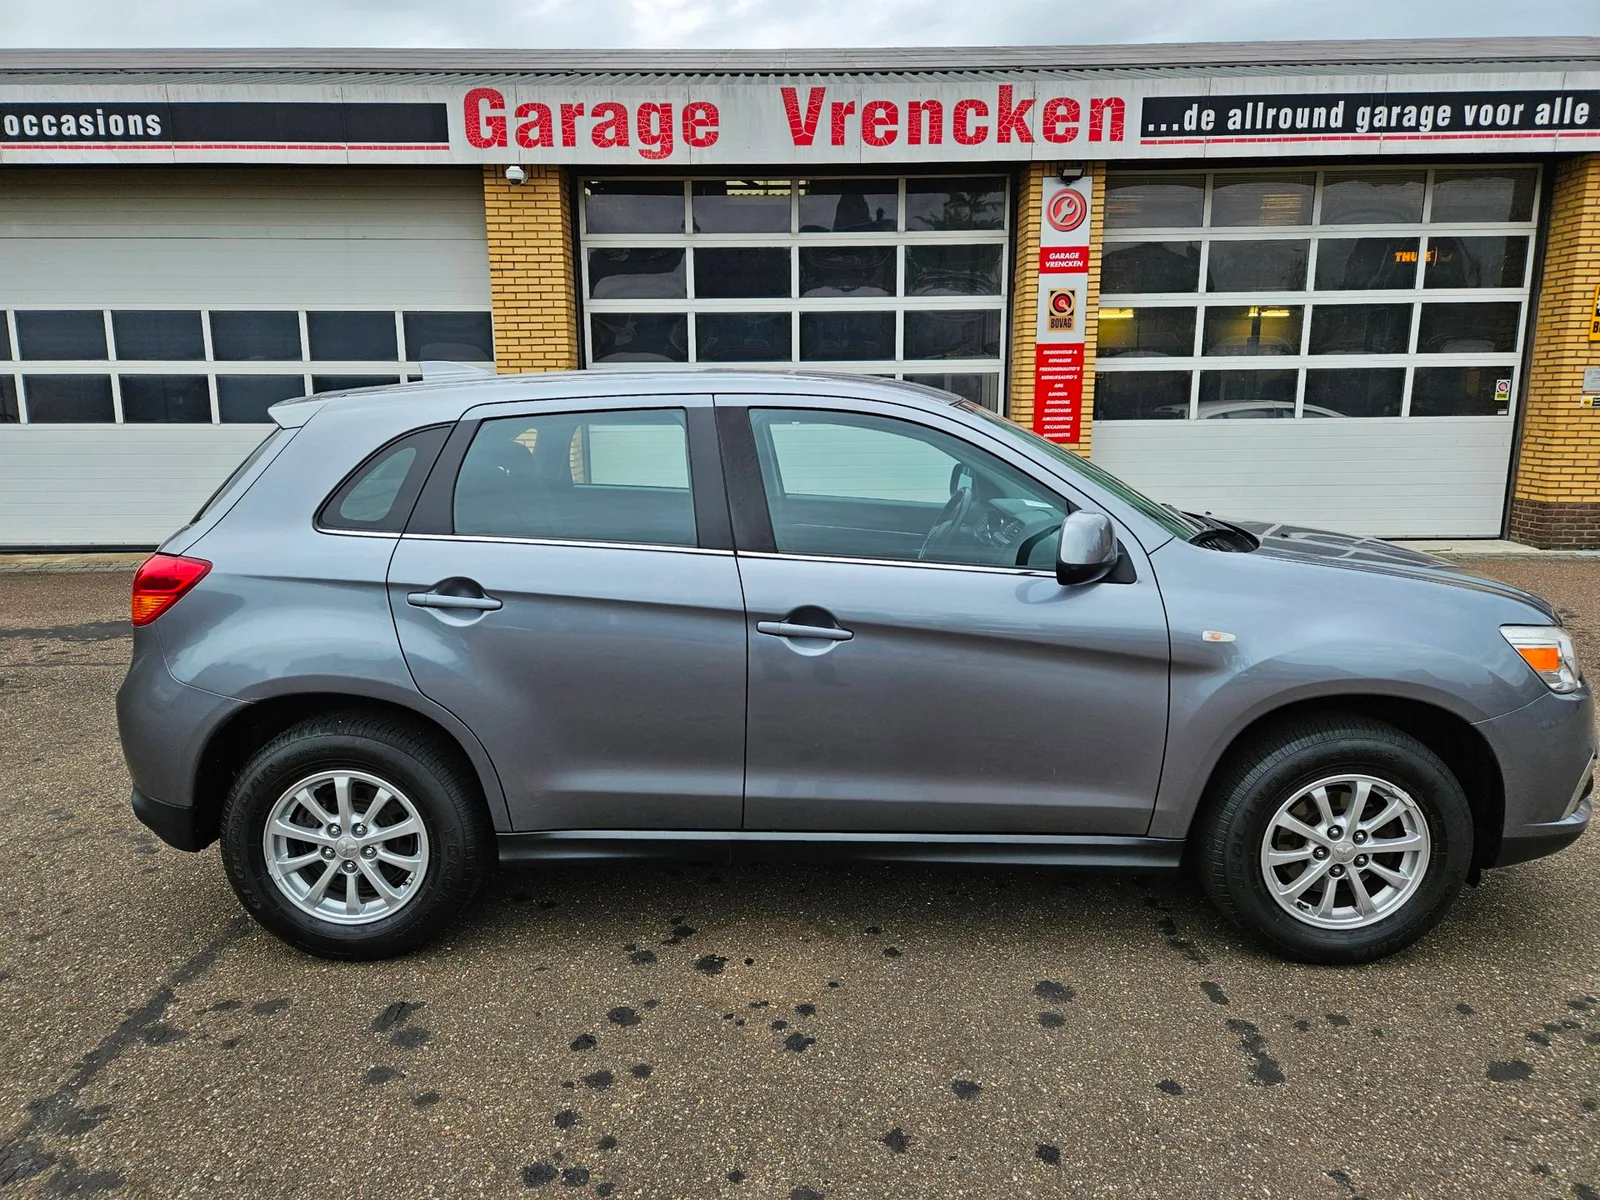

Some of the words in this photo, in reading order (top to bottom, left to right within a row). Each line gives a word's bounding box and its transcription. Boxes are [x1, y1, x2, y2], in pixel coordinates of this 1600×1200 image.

[1227, 100, 1345, 131] allround
[1355, 104, 1452, 133] garage
[1464, 103, 1525, 127] voor
[1535, 96, 1590, 125] alle
[3, 108, 162, 137] occasions
[463, 87, 719, 159] Garage
[780, 84, 1126, 147] Vrencken
[1049, 252, 1080, 260] GARAGE
[1394, 250, 1432, 262] THUE
[1045, 260, 1084, 268] VRENCKEN
[1050, 317, 1072, 329] BOVAG
